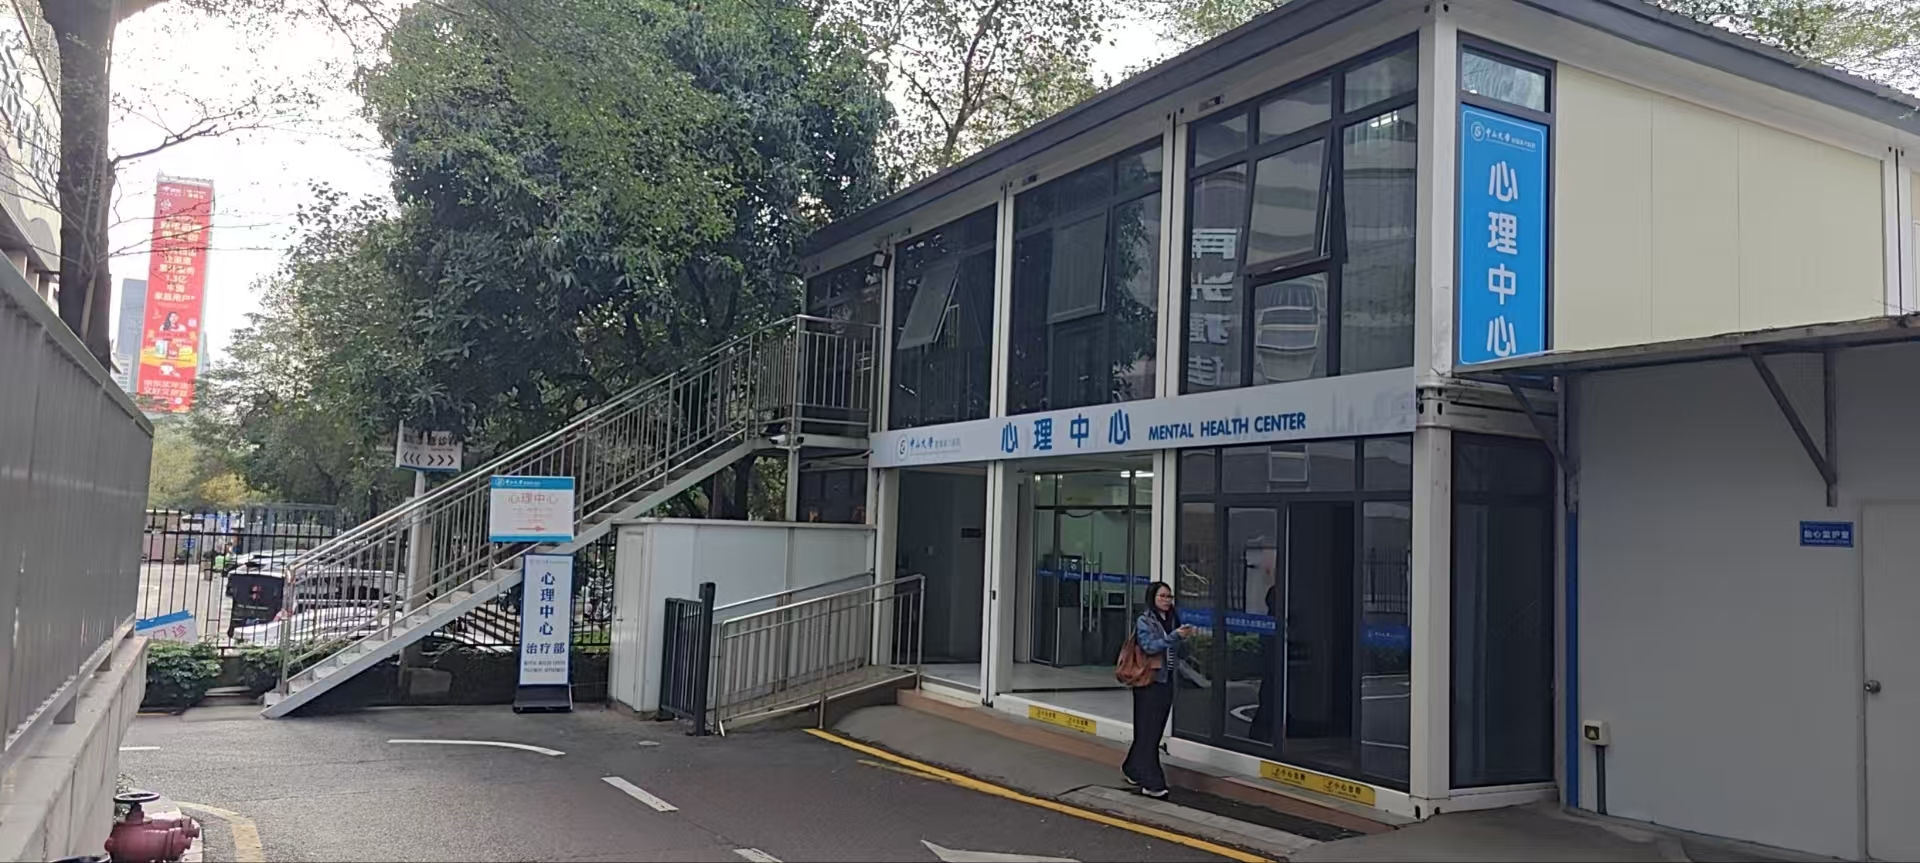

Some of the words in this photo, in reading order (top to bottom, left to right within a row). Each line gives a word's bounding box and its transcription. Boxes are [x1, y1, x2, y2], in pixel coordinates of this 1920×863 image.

[1486, 160, 1518, 357] 心理中心
[1000, 408, 1131, 454] 心理中心
[1148, 422, 1194, 441] MENTAL
[1200, 417, 1249, 437] HEALTH
[1254, 412, 1306, 433] CENTER
[505, 492, 559, 505] 心理中心
[539, 571, 556, 636] 心理中心
[526, 642, 565, 655] 治疗部
